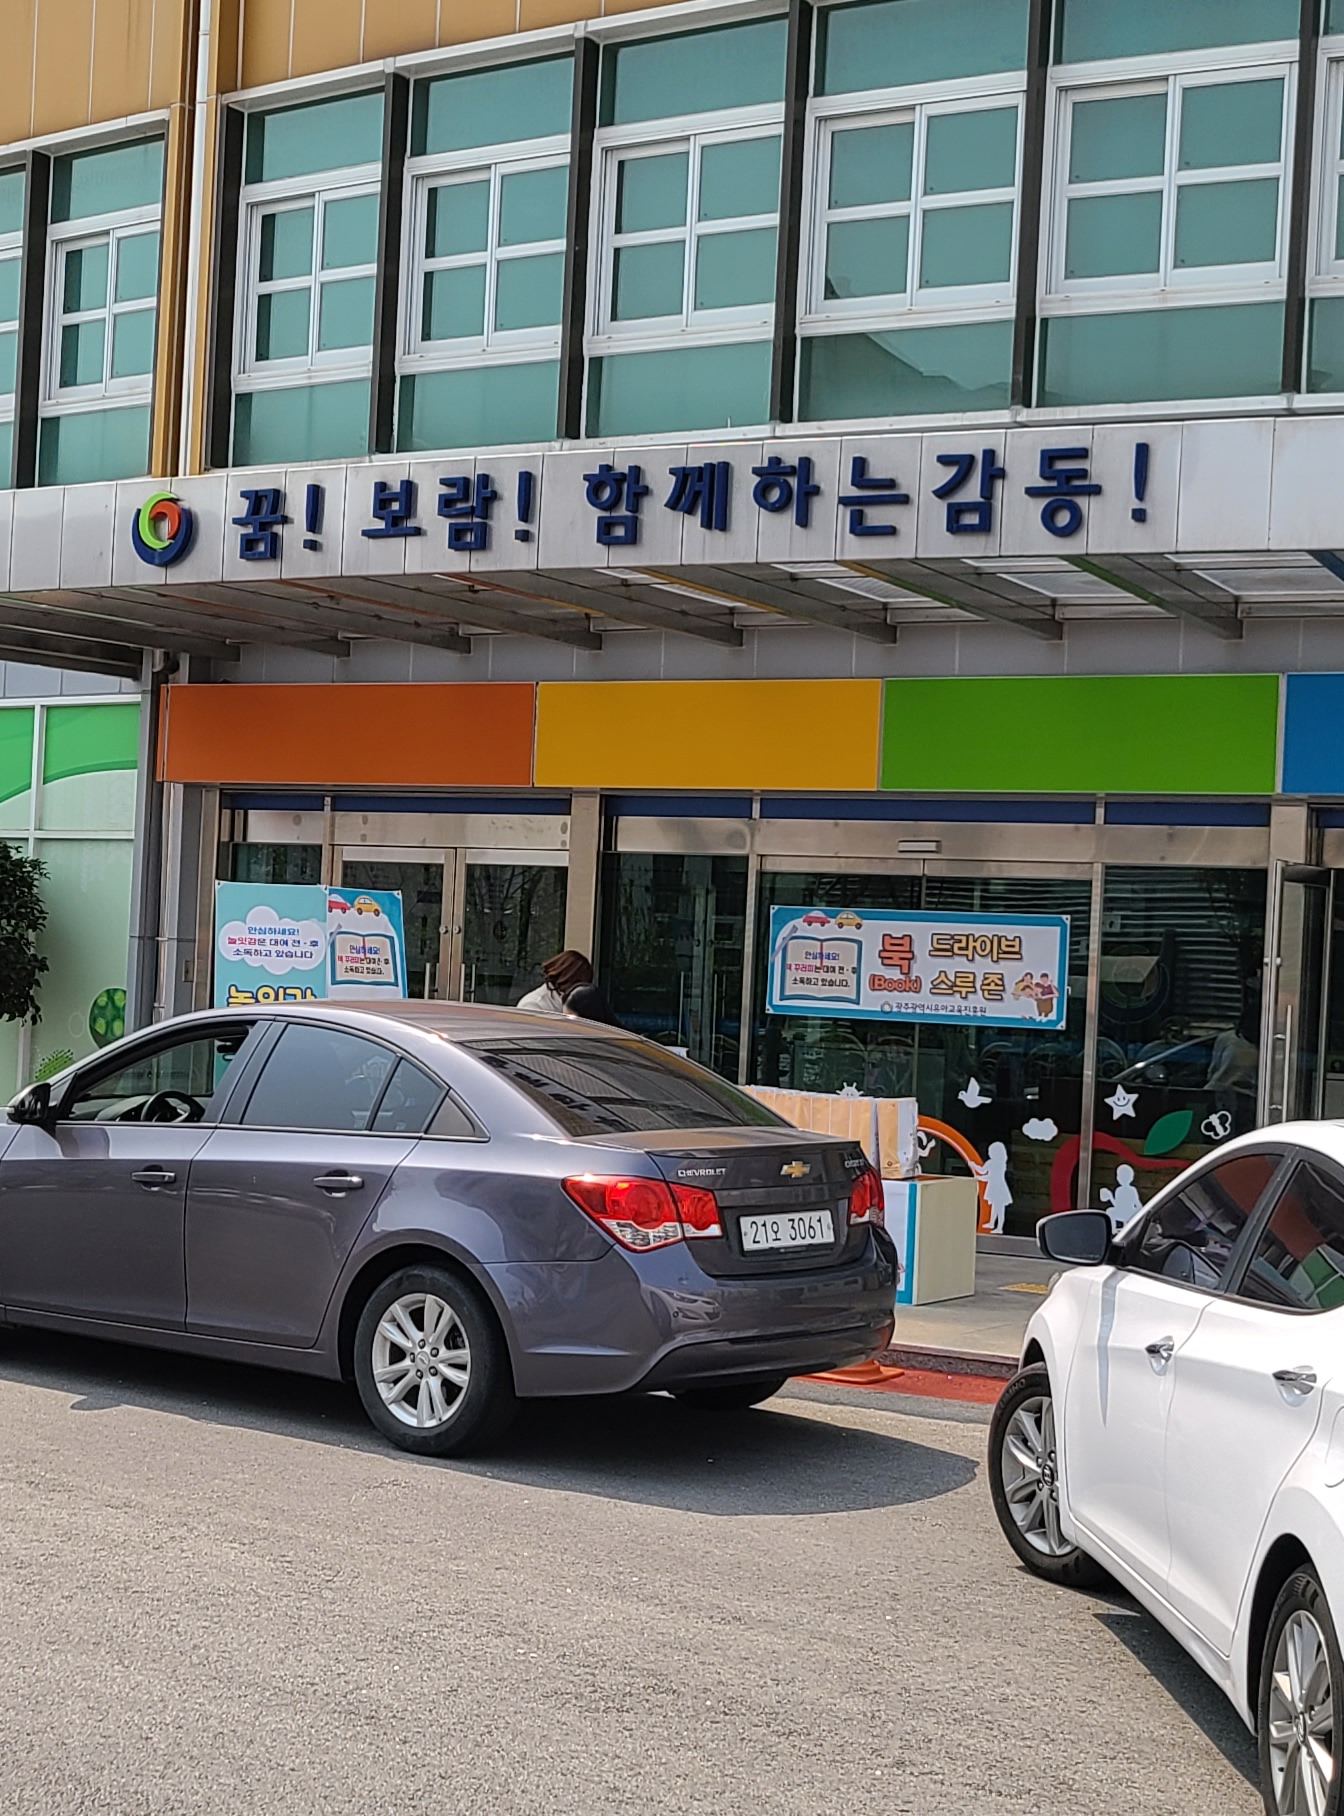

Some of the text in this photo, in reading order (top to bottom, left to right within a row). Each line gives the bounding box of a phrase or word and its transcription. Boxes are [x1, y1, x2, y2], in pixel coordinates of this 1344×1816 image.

[232, 483, 324, 560] 꿈!
[361, 470, 532, 552] 보람!
[248, 926, 300, 935] 안심하세요!
[269, 939, 288, 947] 대여
[233, 949, 313, 959] 소독하고 있습니다
[878, 933, 1023, 975] 북 드라이브
[869, 974, 922, 993] (Book)
[929, 970, 1005, 1001] 스루 존
[677, 1168, 726, 1178] CHEVROLET
[750, 1216, 825, 1244] 21오 3061
